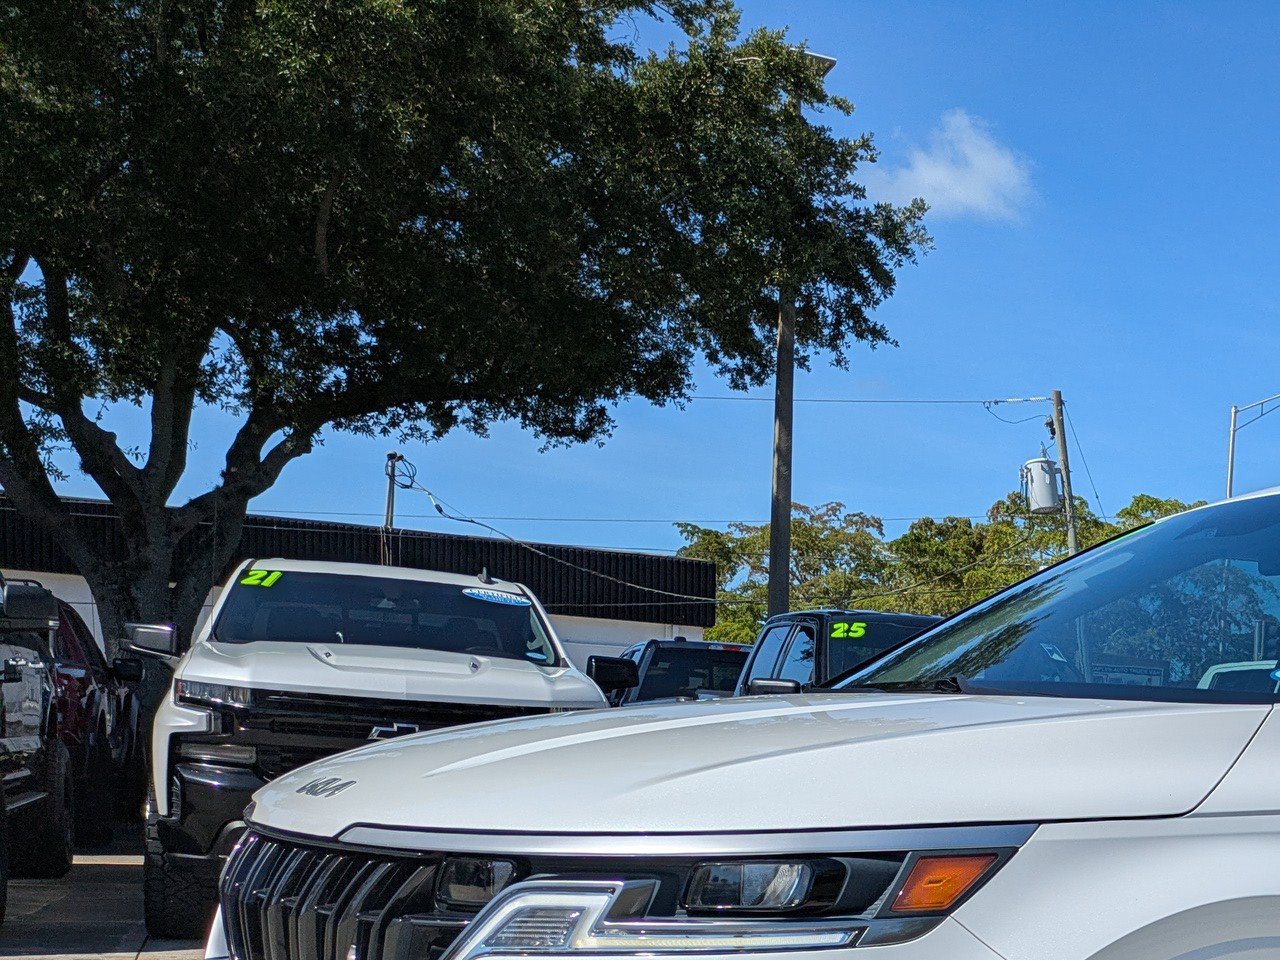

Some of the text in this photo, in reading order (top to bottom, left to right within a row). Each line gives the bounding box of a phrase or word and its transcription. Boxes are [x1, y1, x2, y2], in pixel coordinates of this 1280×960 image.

[241, 570, 283, 588] 21
[831, 622, 867, 638] 25
[296, 776, 357, 798] KIA
